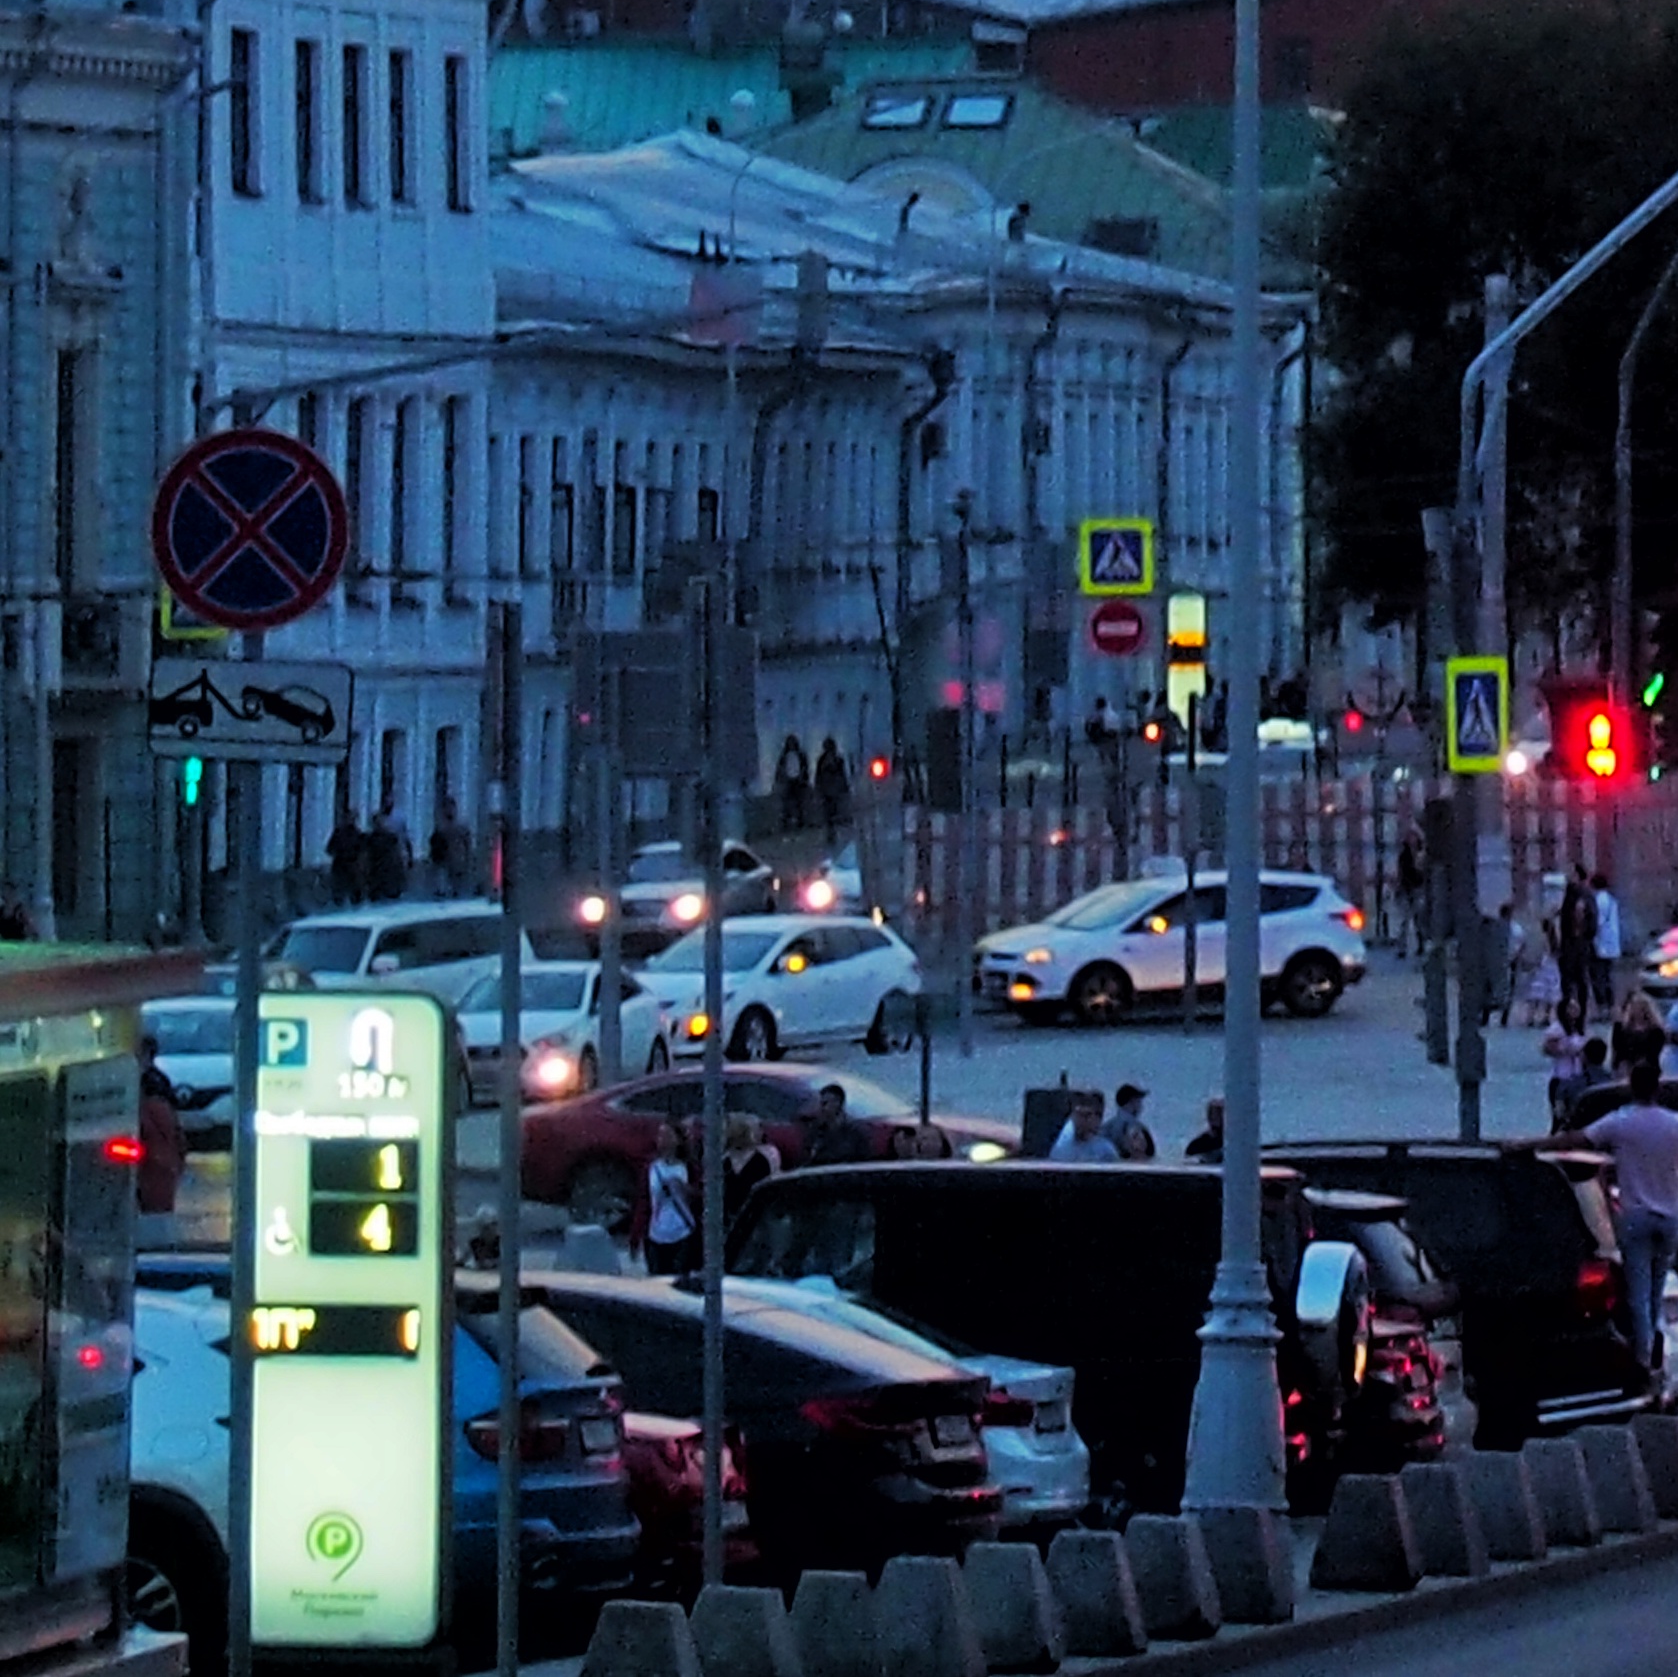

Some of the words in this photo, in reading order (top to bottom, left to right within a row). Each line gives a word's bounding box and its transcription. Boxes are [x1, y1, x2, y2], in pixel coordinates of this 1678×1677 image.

[267, 1021, 300, 1065] P
[379, 1143, 402, 1190] 1
[361, 1202, 392, 1252] 4
